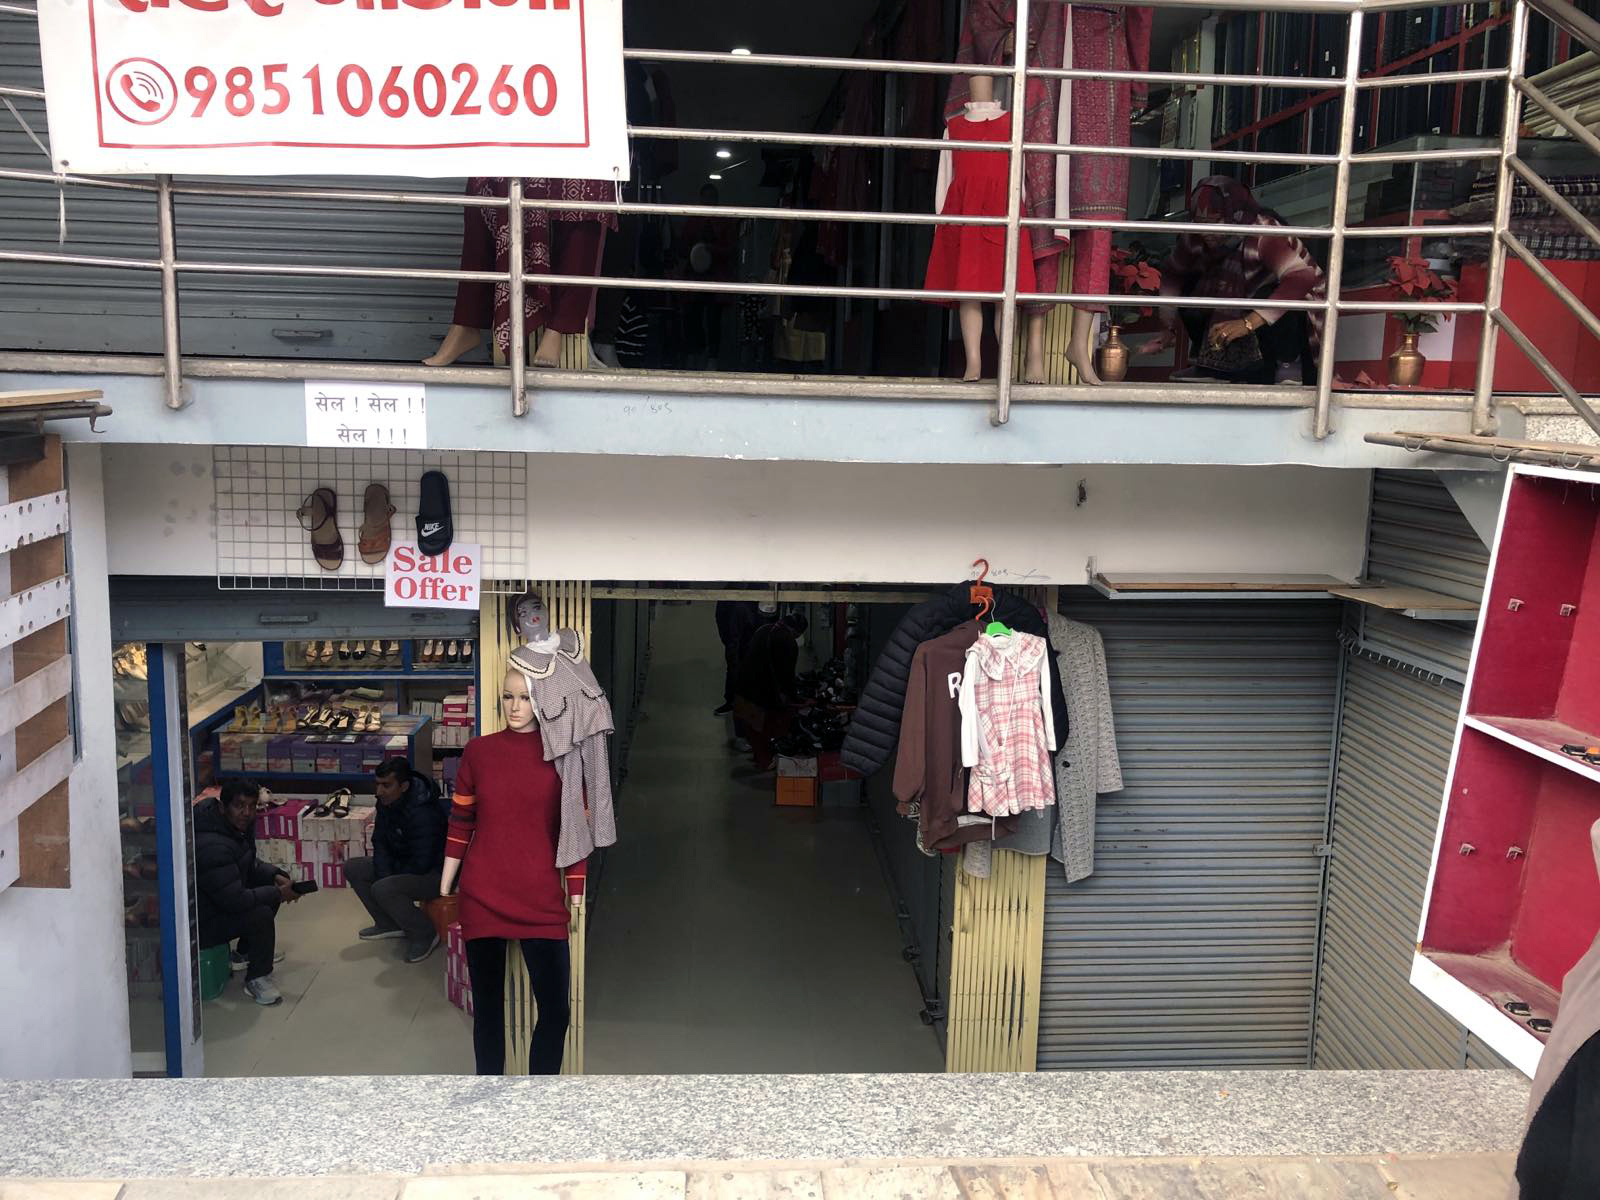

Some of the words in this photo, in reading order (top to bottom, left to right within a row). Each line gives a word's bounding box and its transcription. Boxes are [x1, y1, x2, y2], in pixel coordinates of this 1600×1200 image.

[184, 63, 558, 118] 9851060260
[314, 391, 345, 412] सेल
[367, 392, 399, 413] सेल
[336, 423, 368, 443] सेल
[424, 522, 440, 531] NIKE
[393, 546, 473, 575] Sale
[394, 576, 474, 602] Offer
